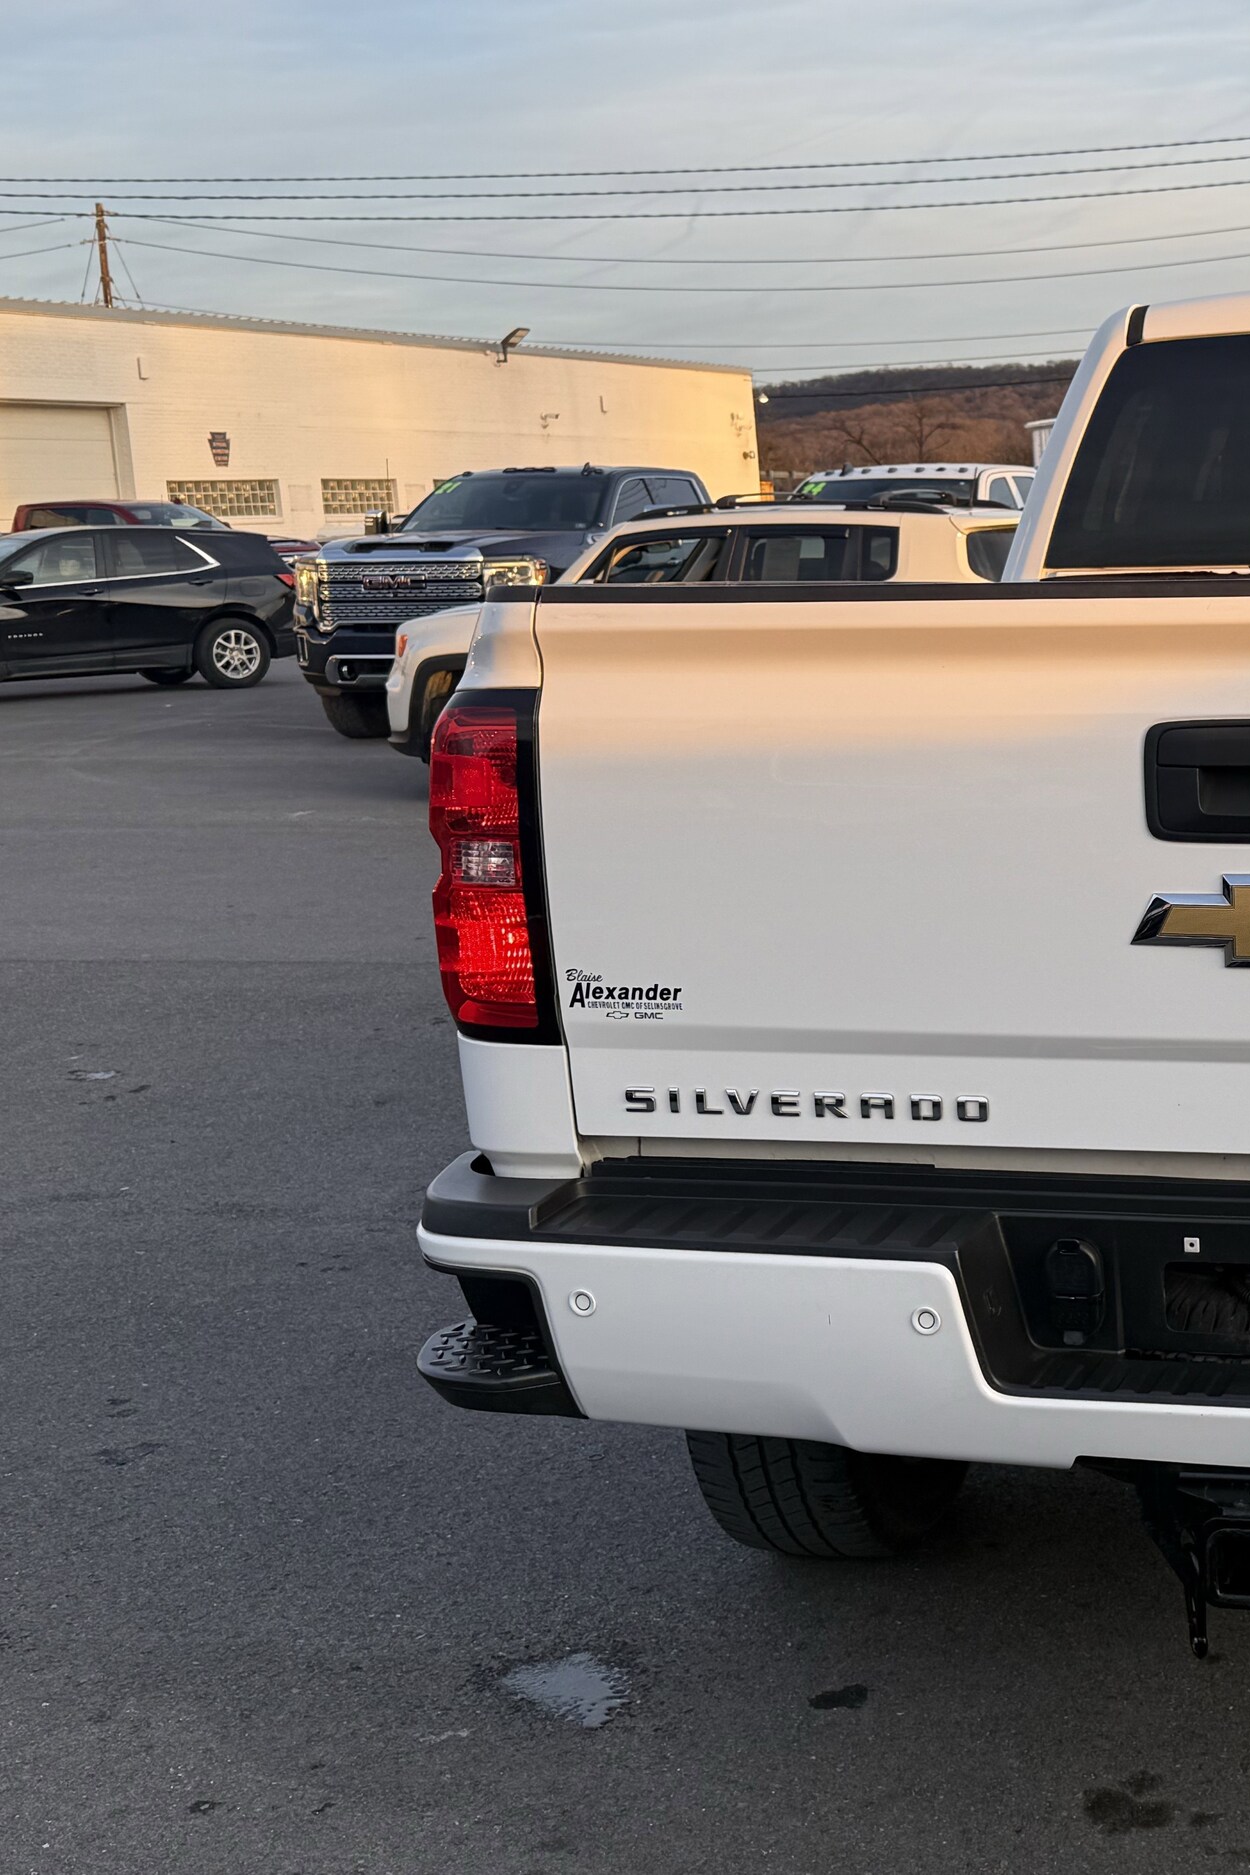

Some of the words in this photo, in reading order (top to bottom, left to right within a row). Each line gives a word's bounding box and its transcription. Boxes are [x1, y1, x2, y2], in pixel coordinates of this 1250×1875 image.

[565, 968, 604, 982] Blaise
[569, 982, 683, 1008] Alexander
[587, 1001, 620, 1009] CHEVROLET
[621, 1001, 635, 1009] GMC
[636, 1001, 643, 1010] OF
[634, 1011, 664, 1020] GMC
[624, 1086, 991, 1123] SILVERADO
